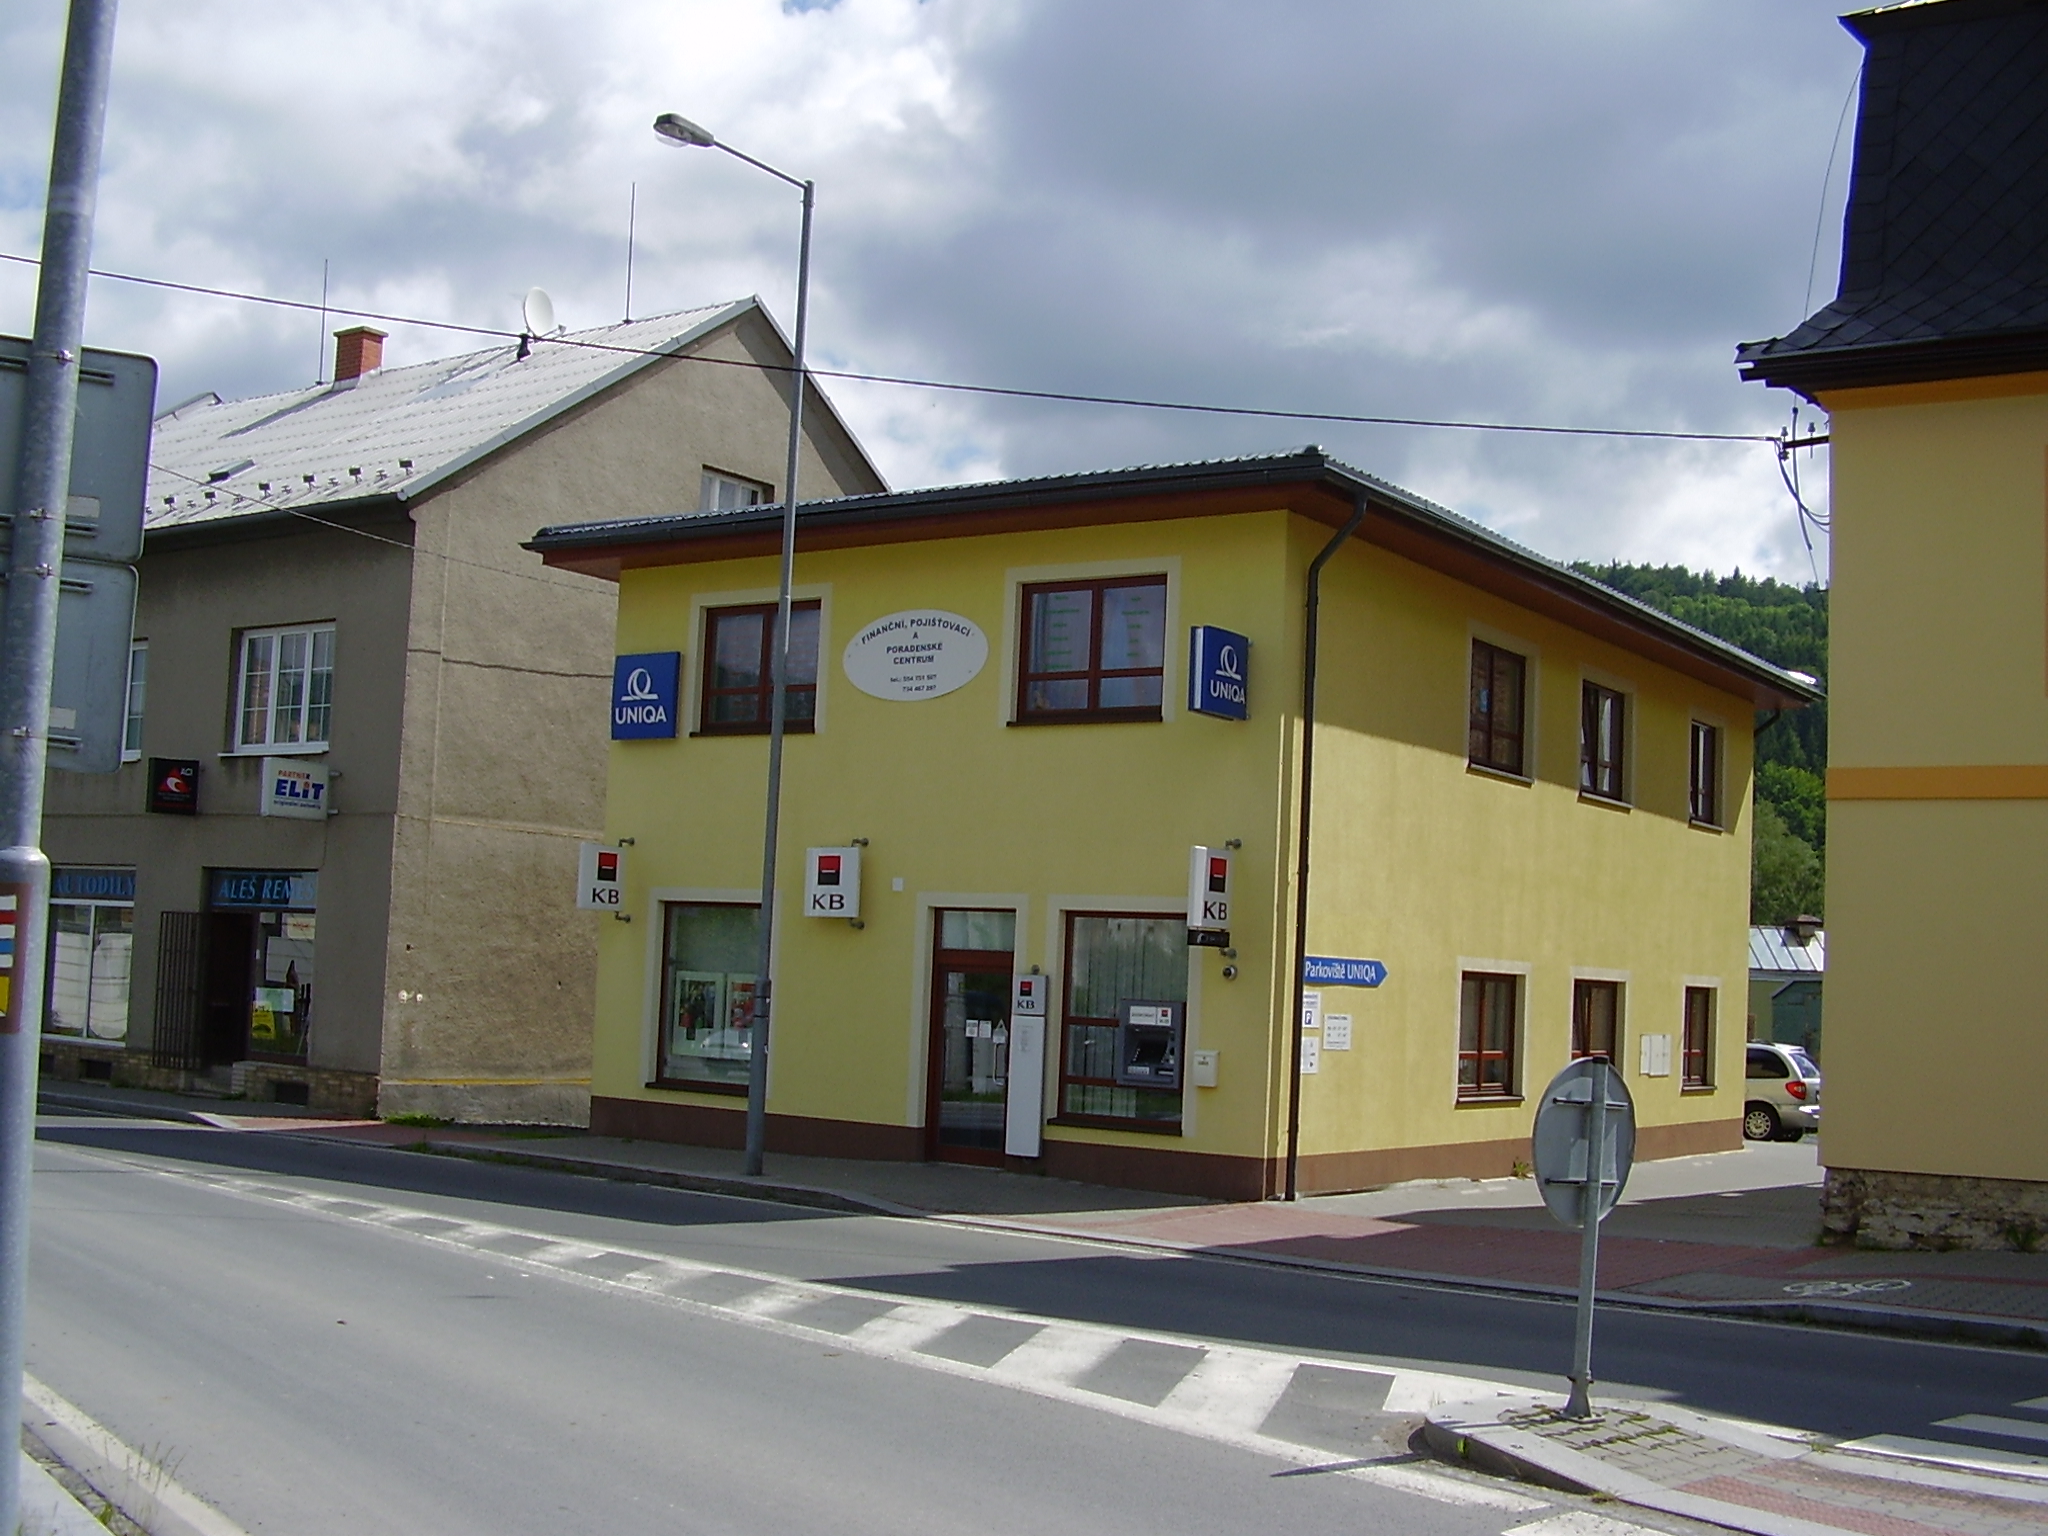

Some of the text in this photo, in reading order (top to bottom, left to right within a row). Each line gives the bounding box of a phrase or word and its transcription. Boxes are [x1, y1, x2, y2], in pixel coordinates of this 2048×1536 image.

[893, 655, 934, 665] CENTRUM
[1210, 679, 1245, 704] UNIQA
[615, 704, 667, 724] UNIQA
[277, 770, 311, 780] PARTNER
[219, 876, 257, 898] ALEŠ
[592, 887, 619, 905] KB
[812, 893, 844, 910] KB
[1203, 900, 1227, 921] KB
[1305, 961, 1376, 983] Parkoviště UNIQA
[1017, 1000, 1035, 1009] KB
